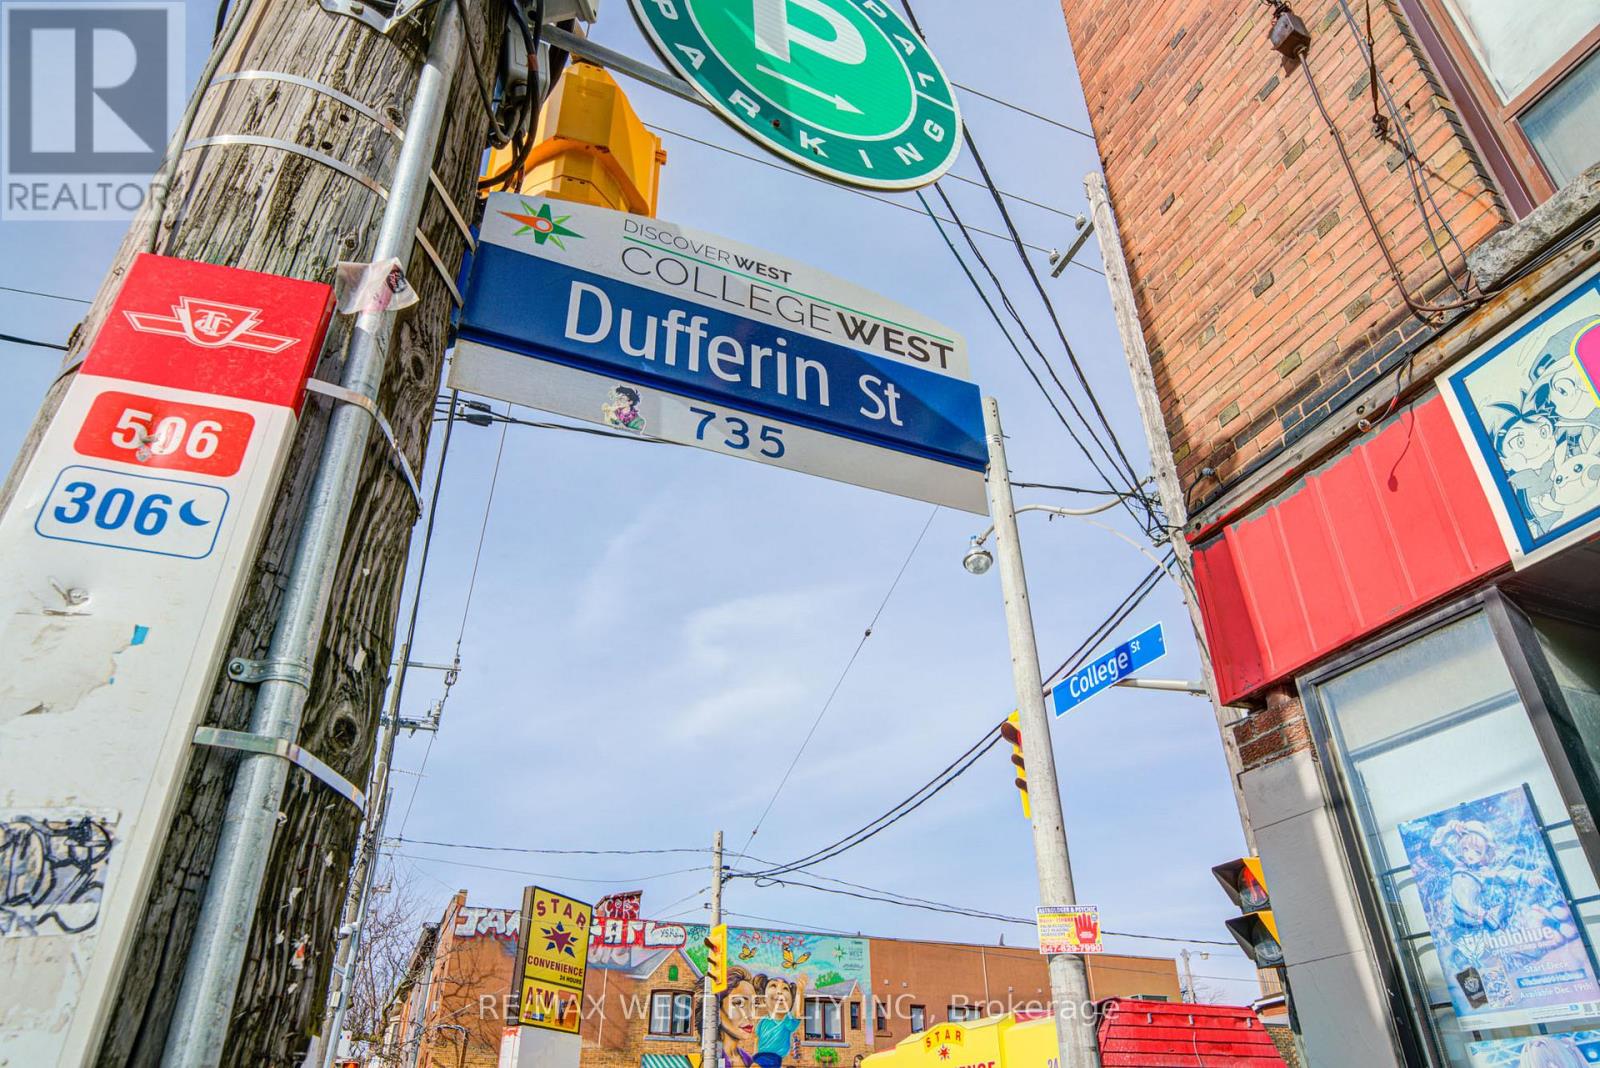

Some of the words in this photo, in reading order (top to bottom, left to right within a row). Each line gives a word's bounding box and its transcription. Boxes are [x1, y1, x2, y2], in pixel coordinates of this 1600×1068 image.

[651, 0, 945, 169] PARKING
[622, 217, 731, 266] DISCOVER
[734, 254, 793, 284] WEST
[564, 280, 831, 408] Dufferin
[859, 373, 904, 428] St
[110, 407, 223, 460] 506
[688, 405, 786, 460] 735
[53, 481, 173, 536] 306
[1069, 651, 1129, 698] College
[1130, 639, 1141, 654] St
[536, 897, 587, 931] STAR
[1485, 925, 1554, 949] hololive
[527, 954, 583, 977] CONVENIENCE
[566, 977, 582, 985] HOURS
[926, 1029, 962, 1048] STAR
